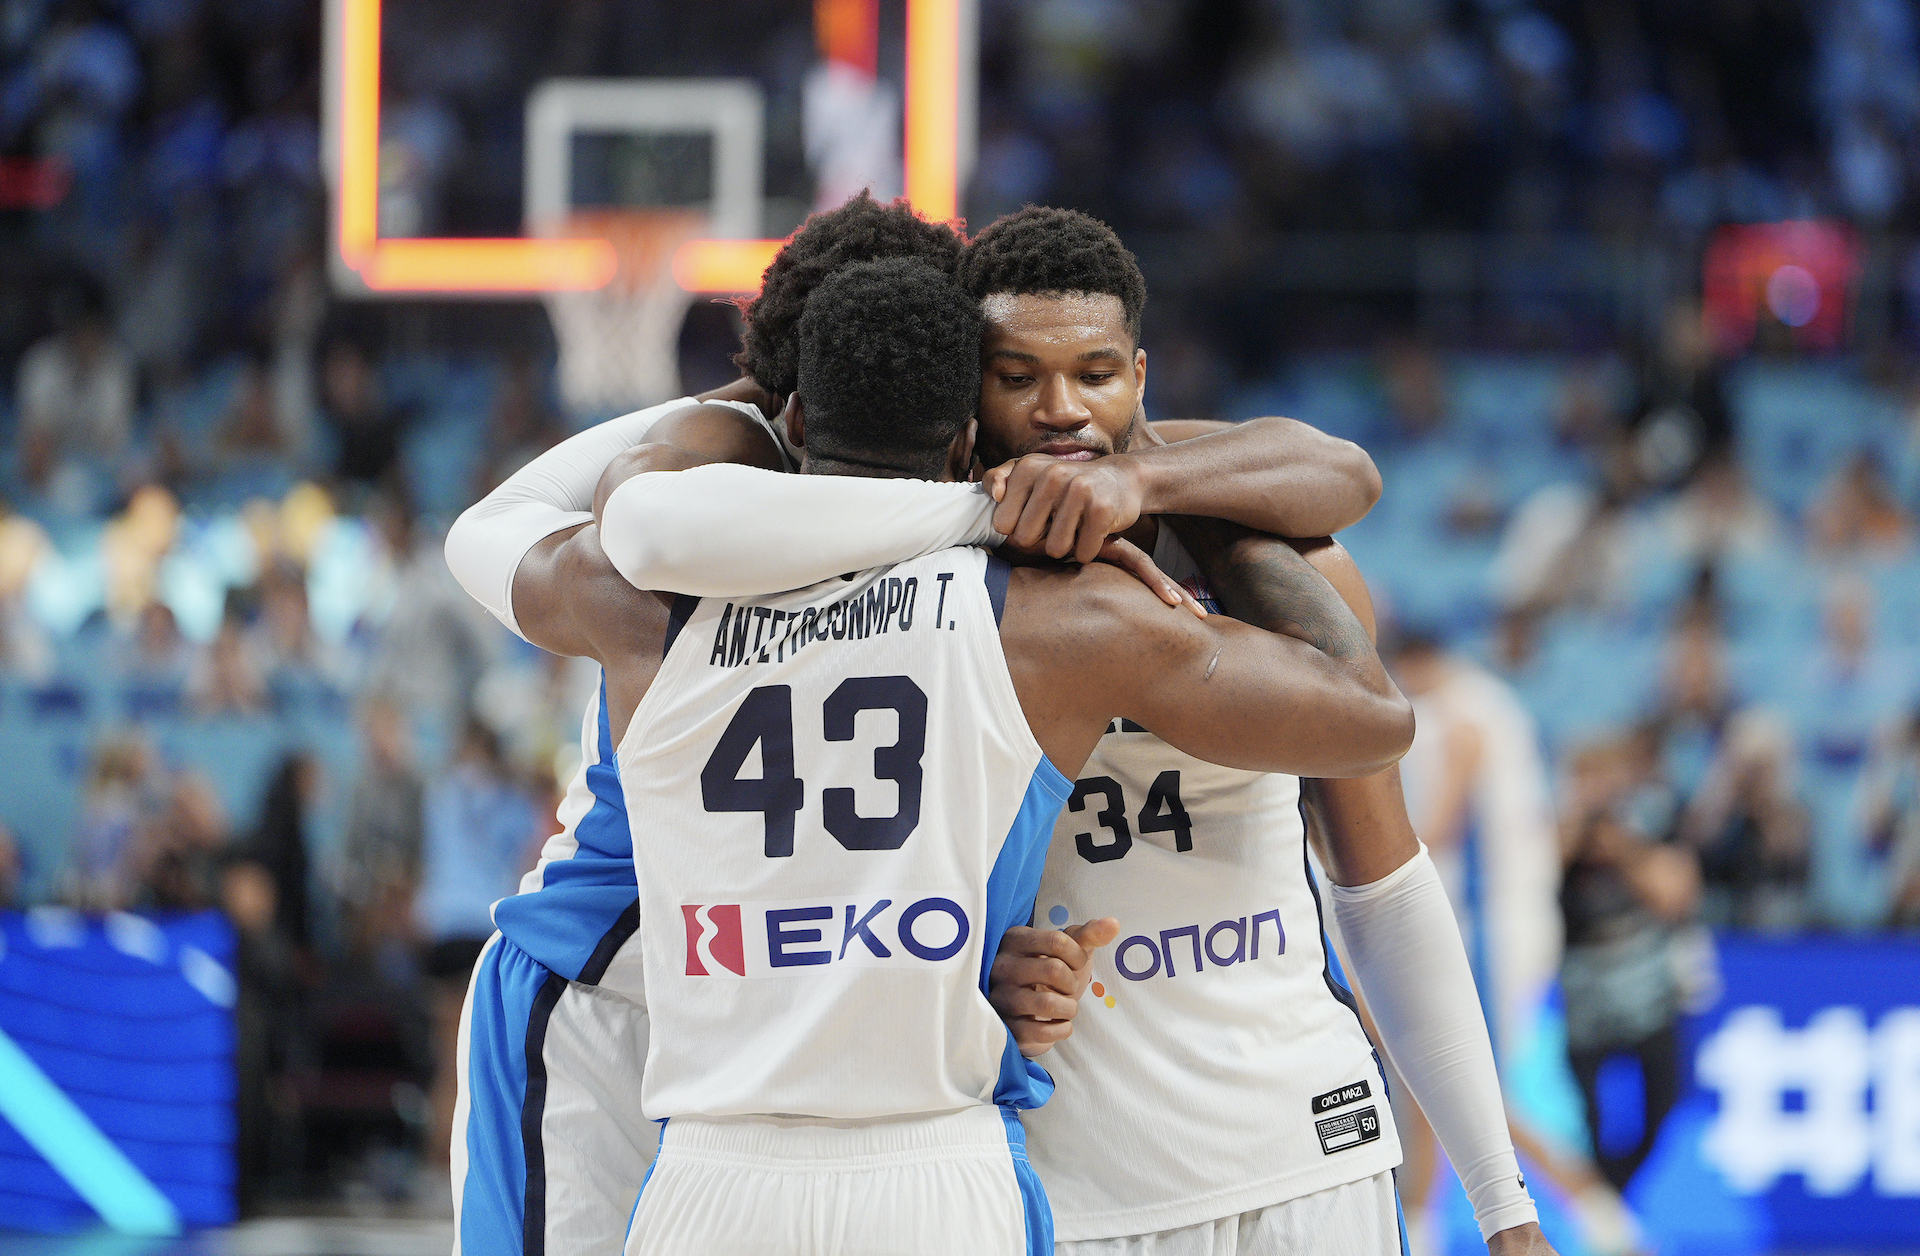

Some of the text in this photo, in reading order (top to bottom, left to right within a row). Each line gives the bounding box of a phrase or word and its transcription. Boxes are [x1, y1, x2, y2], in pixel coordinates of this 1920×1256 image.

[936, 572, 955, 631] T.
[700, 675, 928, 858] 43
[1067, 770, 1193, 864] 34
[765, 897, 970, 969] EKO
[1361, 1116, 1377, 1132] 50
